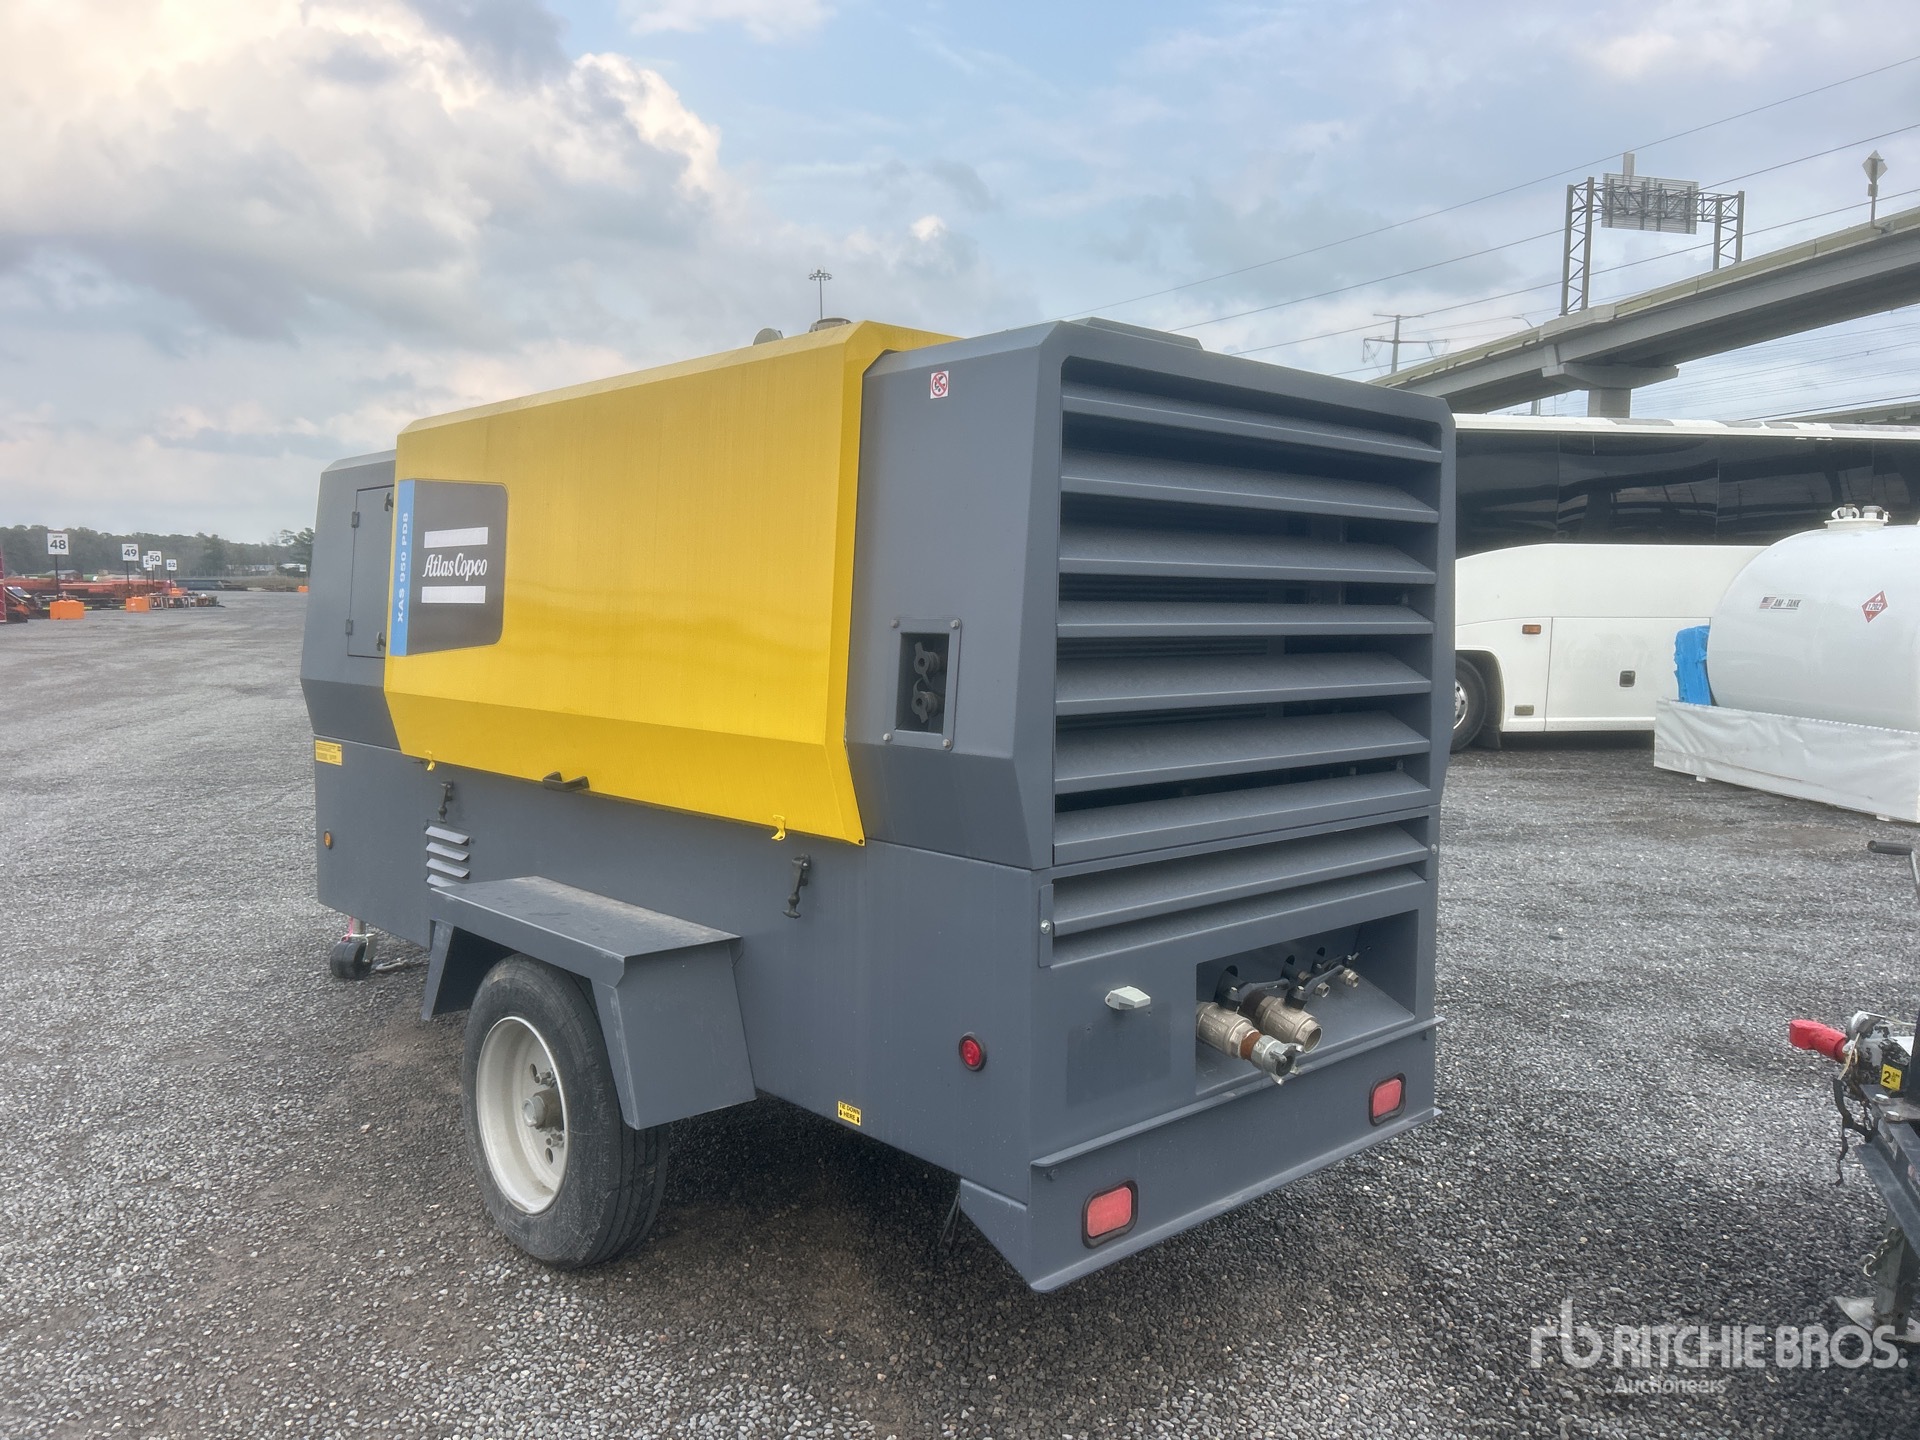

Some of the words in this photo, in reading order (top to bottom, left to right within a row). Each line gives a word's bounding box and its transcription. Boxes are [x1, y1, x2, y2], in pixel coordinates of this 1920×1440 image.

[50, 540, 67, 550] 48
[124, 548, 137, 557] 49
[399, 551, 407, 583] 950
[422, 553, 454, 578] Atlas
[454, 552, 488, 581] Copco
[397, 587, 405, 623] XAS
[843, 1111, 856, 1121] HERE
